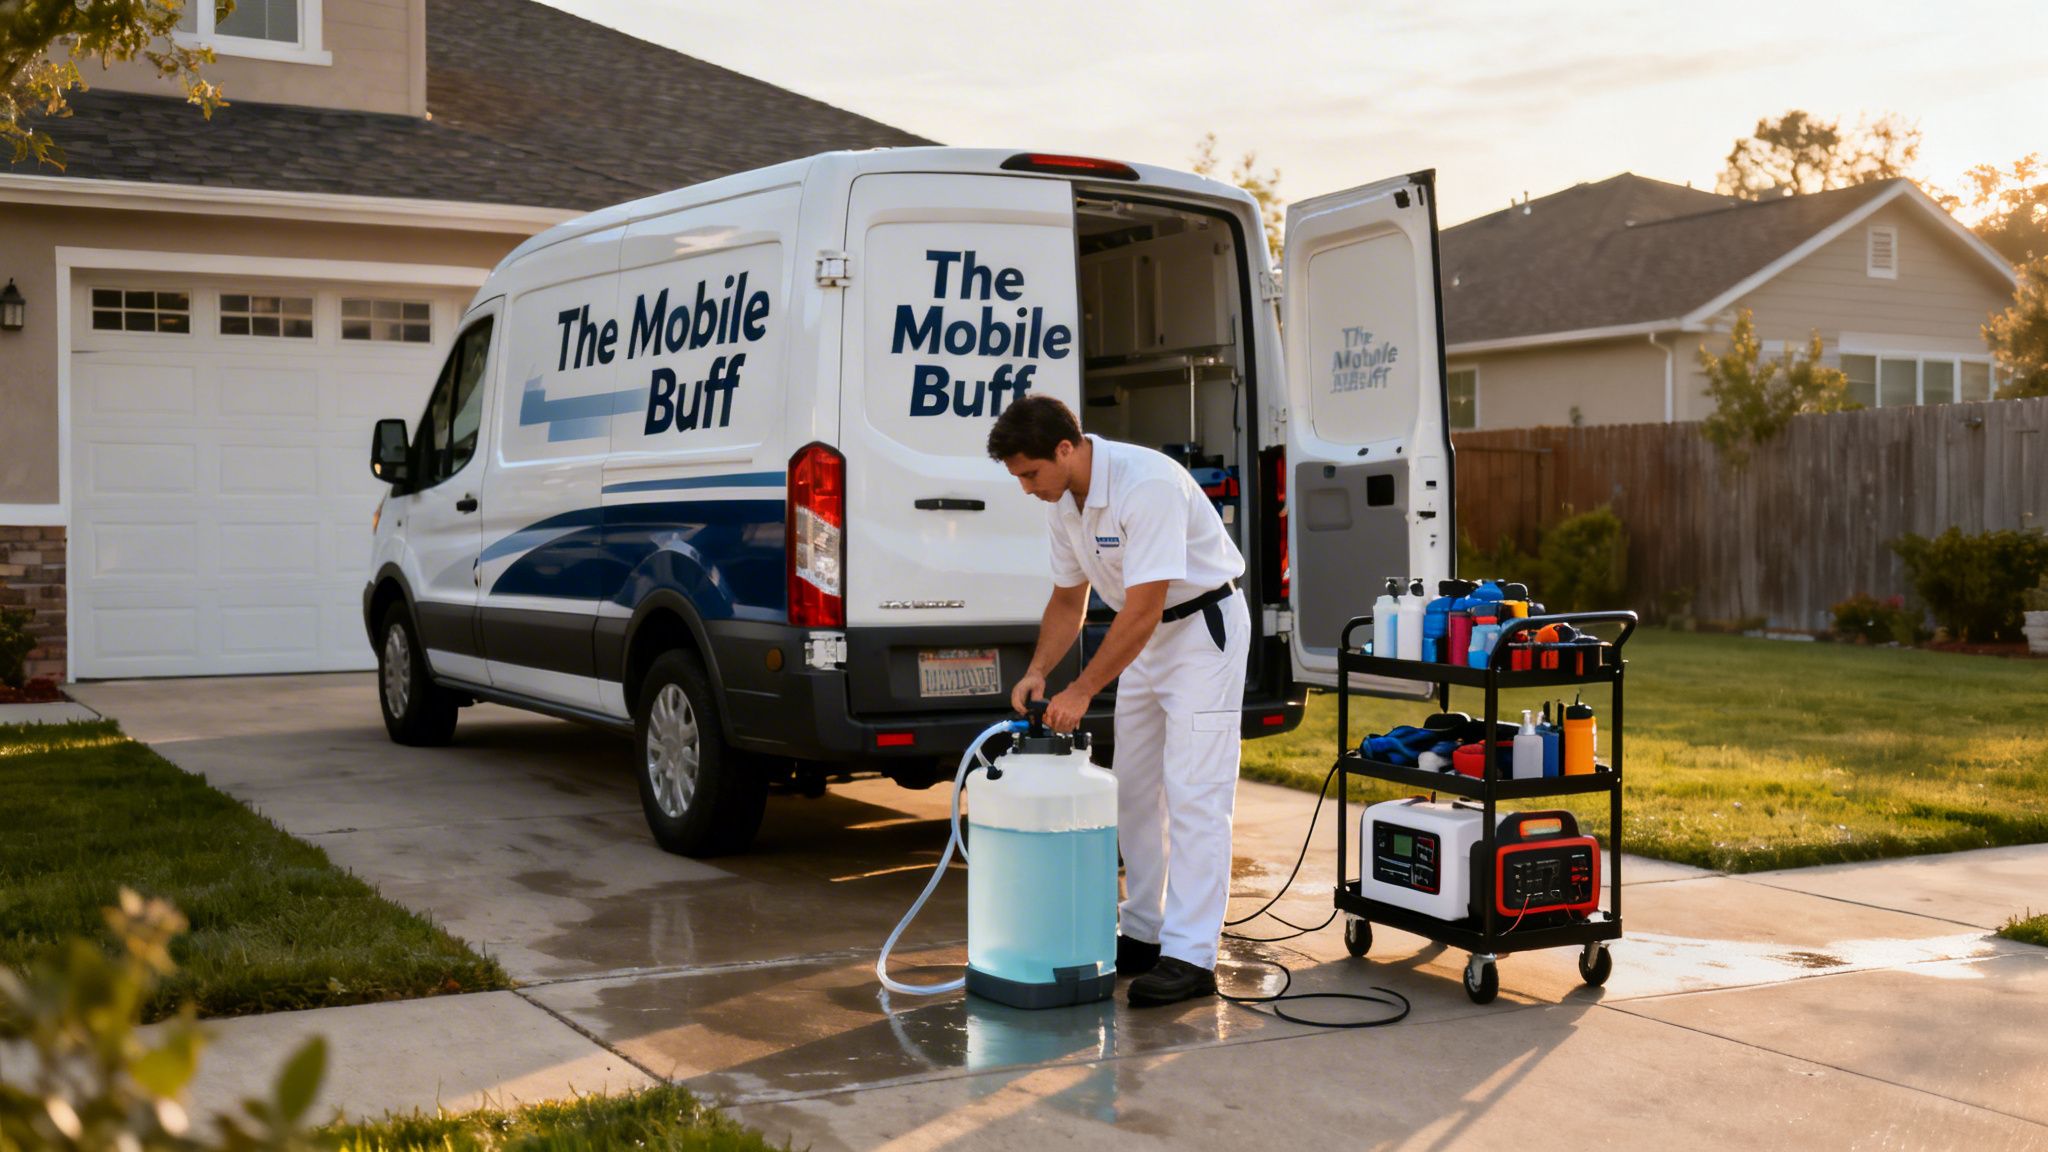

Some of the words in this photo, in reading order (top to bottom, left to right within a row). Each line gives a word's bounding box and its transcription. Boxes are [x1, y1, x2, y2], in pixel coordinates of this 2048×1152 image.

[926, 250, 1024, 301] The
[558, 304, 618, 371] The
[627, 271, 770, 359] Mobile
[891, 305, 1071, 359] Mobile
[644, 353, 746, 435] Buff
[910, 364, 1037, 417] Buff
